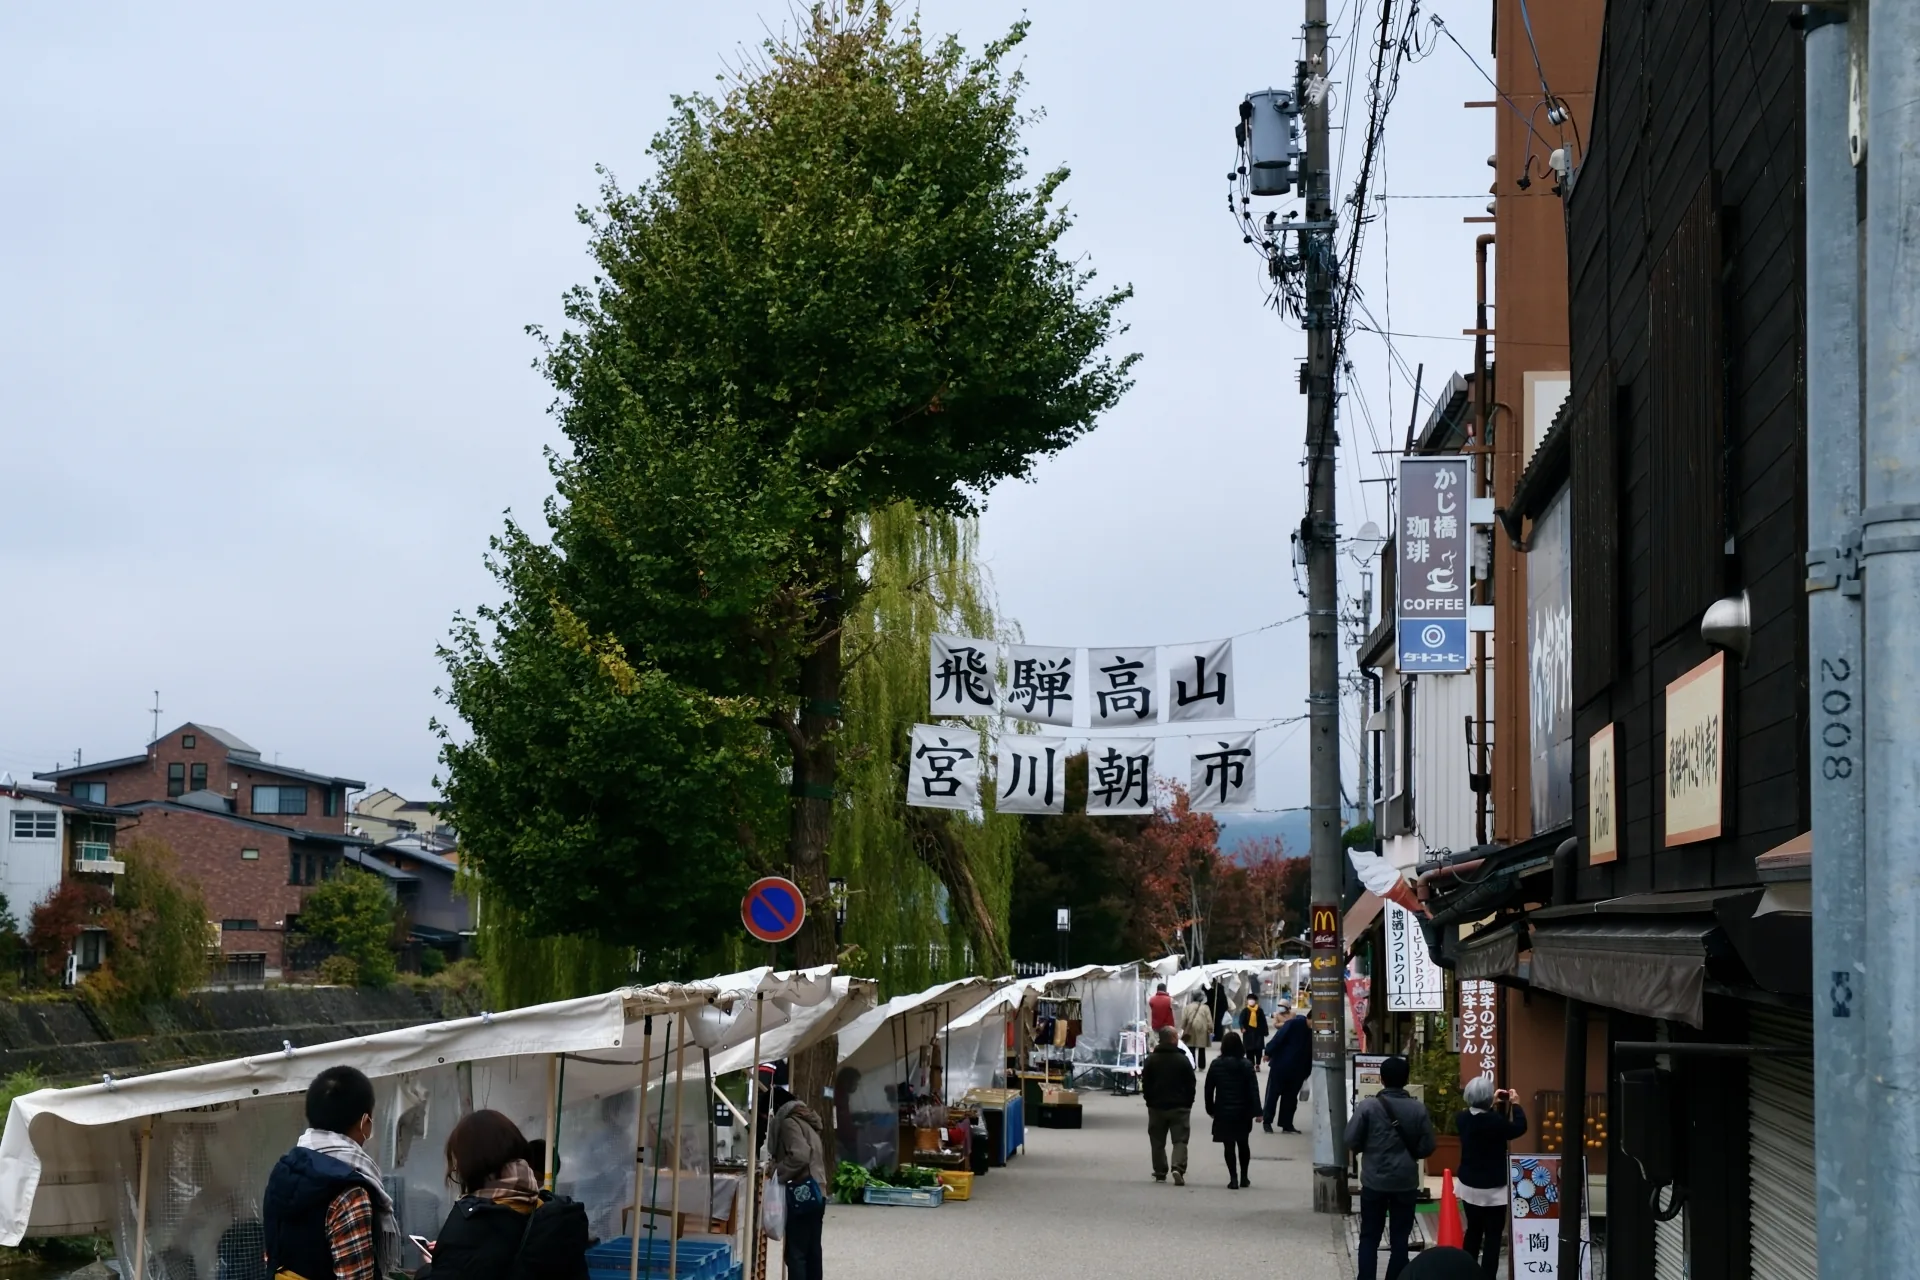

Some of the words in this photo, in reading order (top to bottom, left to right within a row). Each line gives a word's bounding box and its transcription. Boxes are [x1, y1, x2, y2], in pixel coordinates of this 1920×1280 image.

[1433, 467, 1458, 539] かじ橋
[1406, 516, 1430, 564] 珈琲
[1403, 598, 1464, 611] COFFEE
[934, 646, 1227, 719] 飛騨高山
[1403, 652, 1465, 663] ダートコーヒー
[1821, 657, 1852, 781] 2008
[915, 737, 1252, 808] 宮川朝市
[1391, 908, 1406, 1006] 地酒ソフトクリーム
